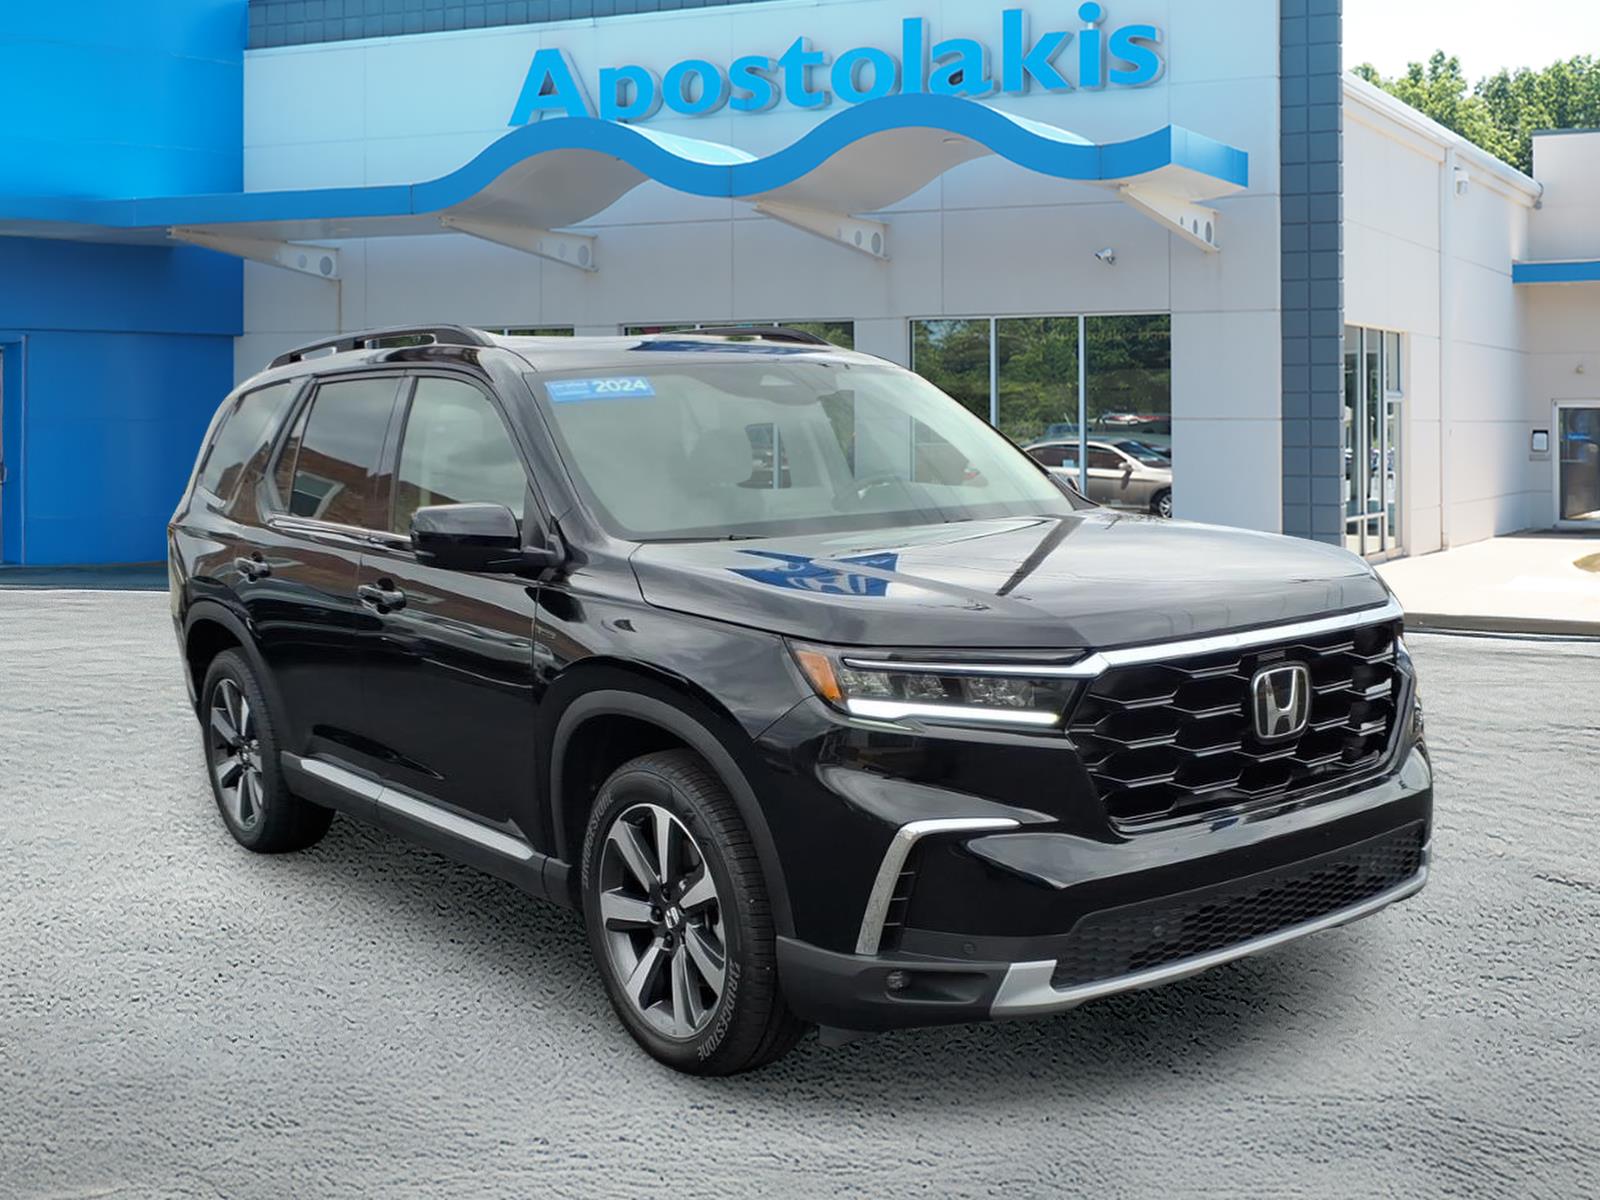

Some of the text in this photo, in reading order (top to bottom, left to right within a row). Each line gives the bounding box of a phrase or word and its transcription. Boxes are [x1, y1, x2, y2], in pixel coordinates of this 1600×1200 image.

[508, 1, 1163, 126] Apostolakis
[592, 379, 648, 393] 2024
[697, 957, 741, 1062] BRIDGESTONE
